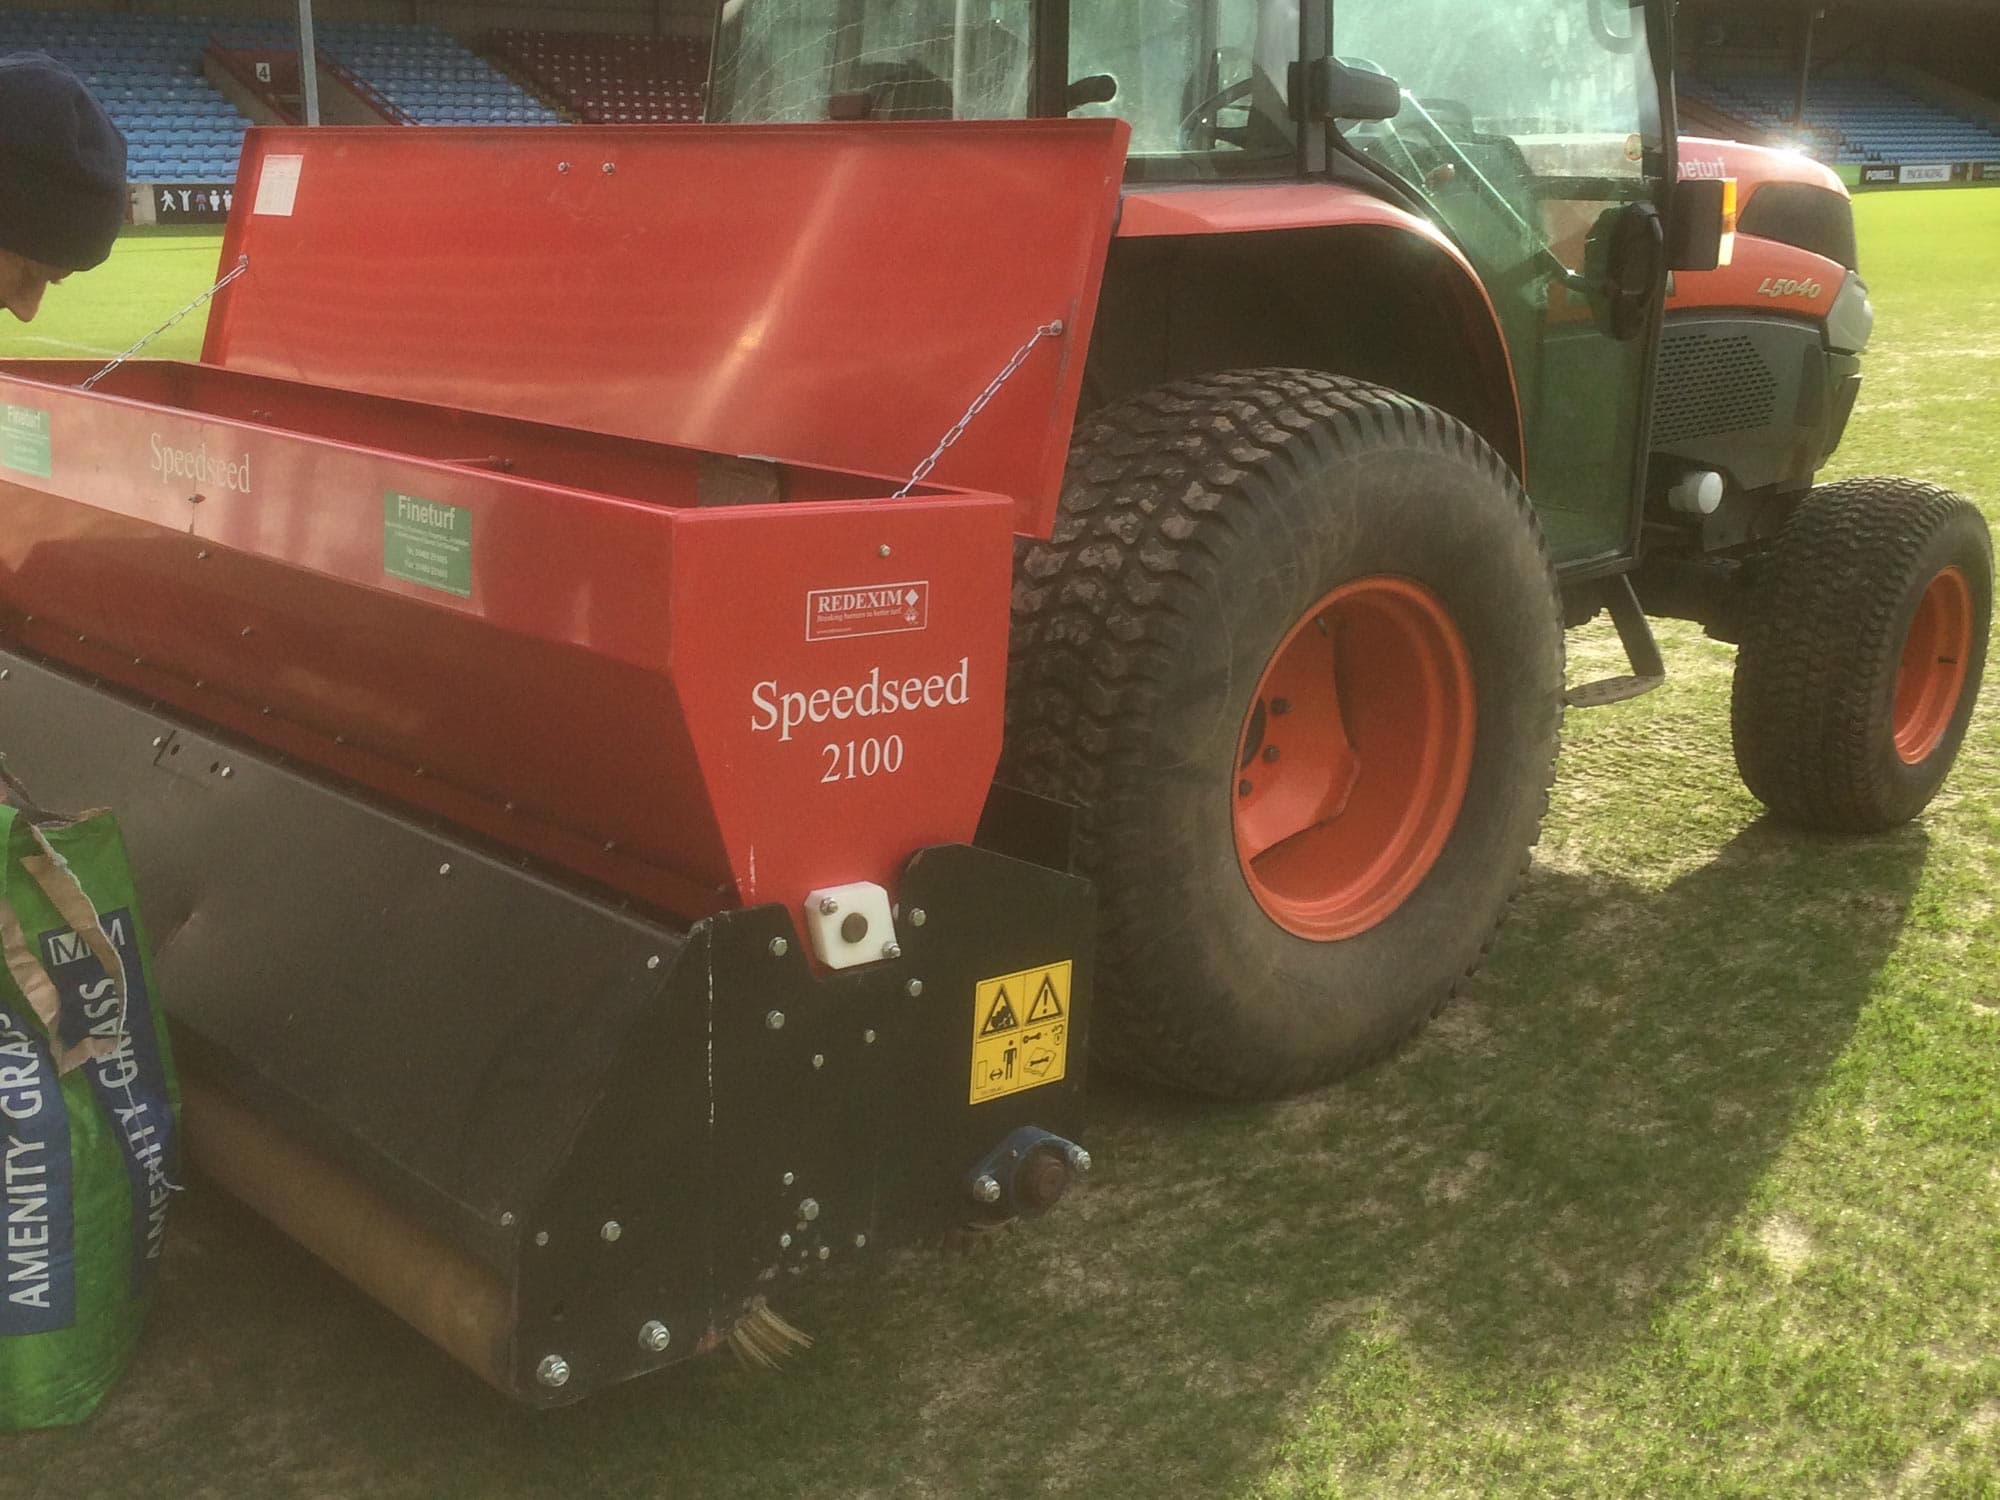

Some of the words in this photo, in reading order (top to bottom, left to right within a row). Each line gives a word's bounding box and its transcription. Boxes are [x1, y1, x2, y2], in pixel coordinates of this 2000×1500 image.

[258, 65, 269, 81] 4
[1677, 157, 1726, 178] neturf
[1758, 277, 1822, 299] L5040
[151, 432, 251, 494] Speedseed
[398, 494, 456, 531] Fineturf
[818, 590, 903, 614] REDEXIM
[751, 656, 970, 742] Speedseed
[820, 734, 904, 783] 2100
[7, 1135, 51, 1308] AMENITY
